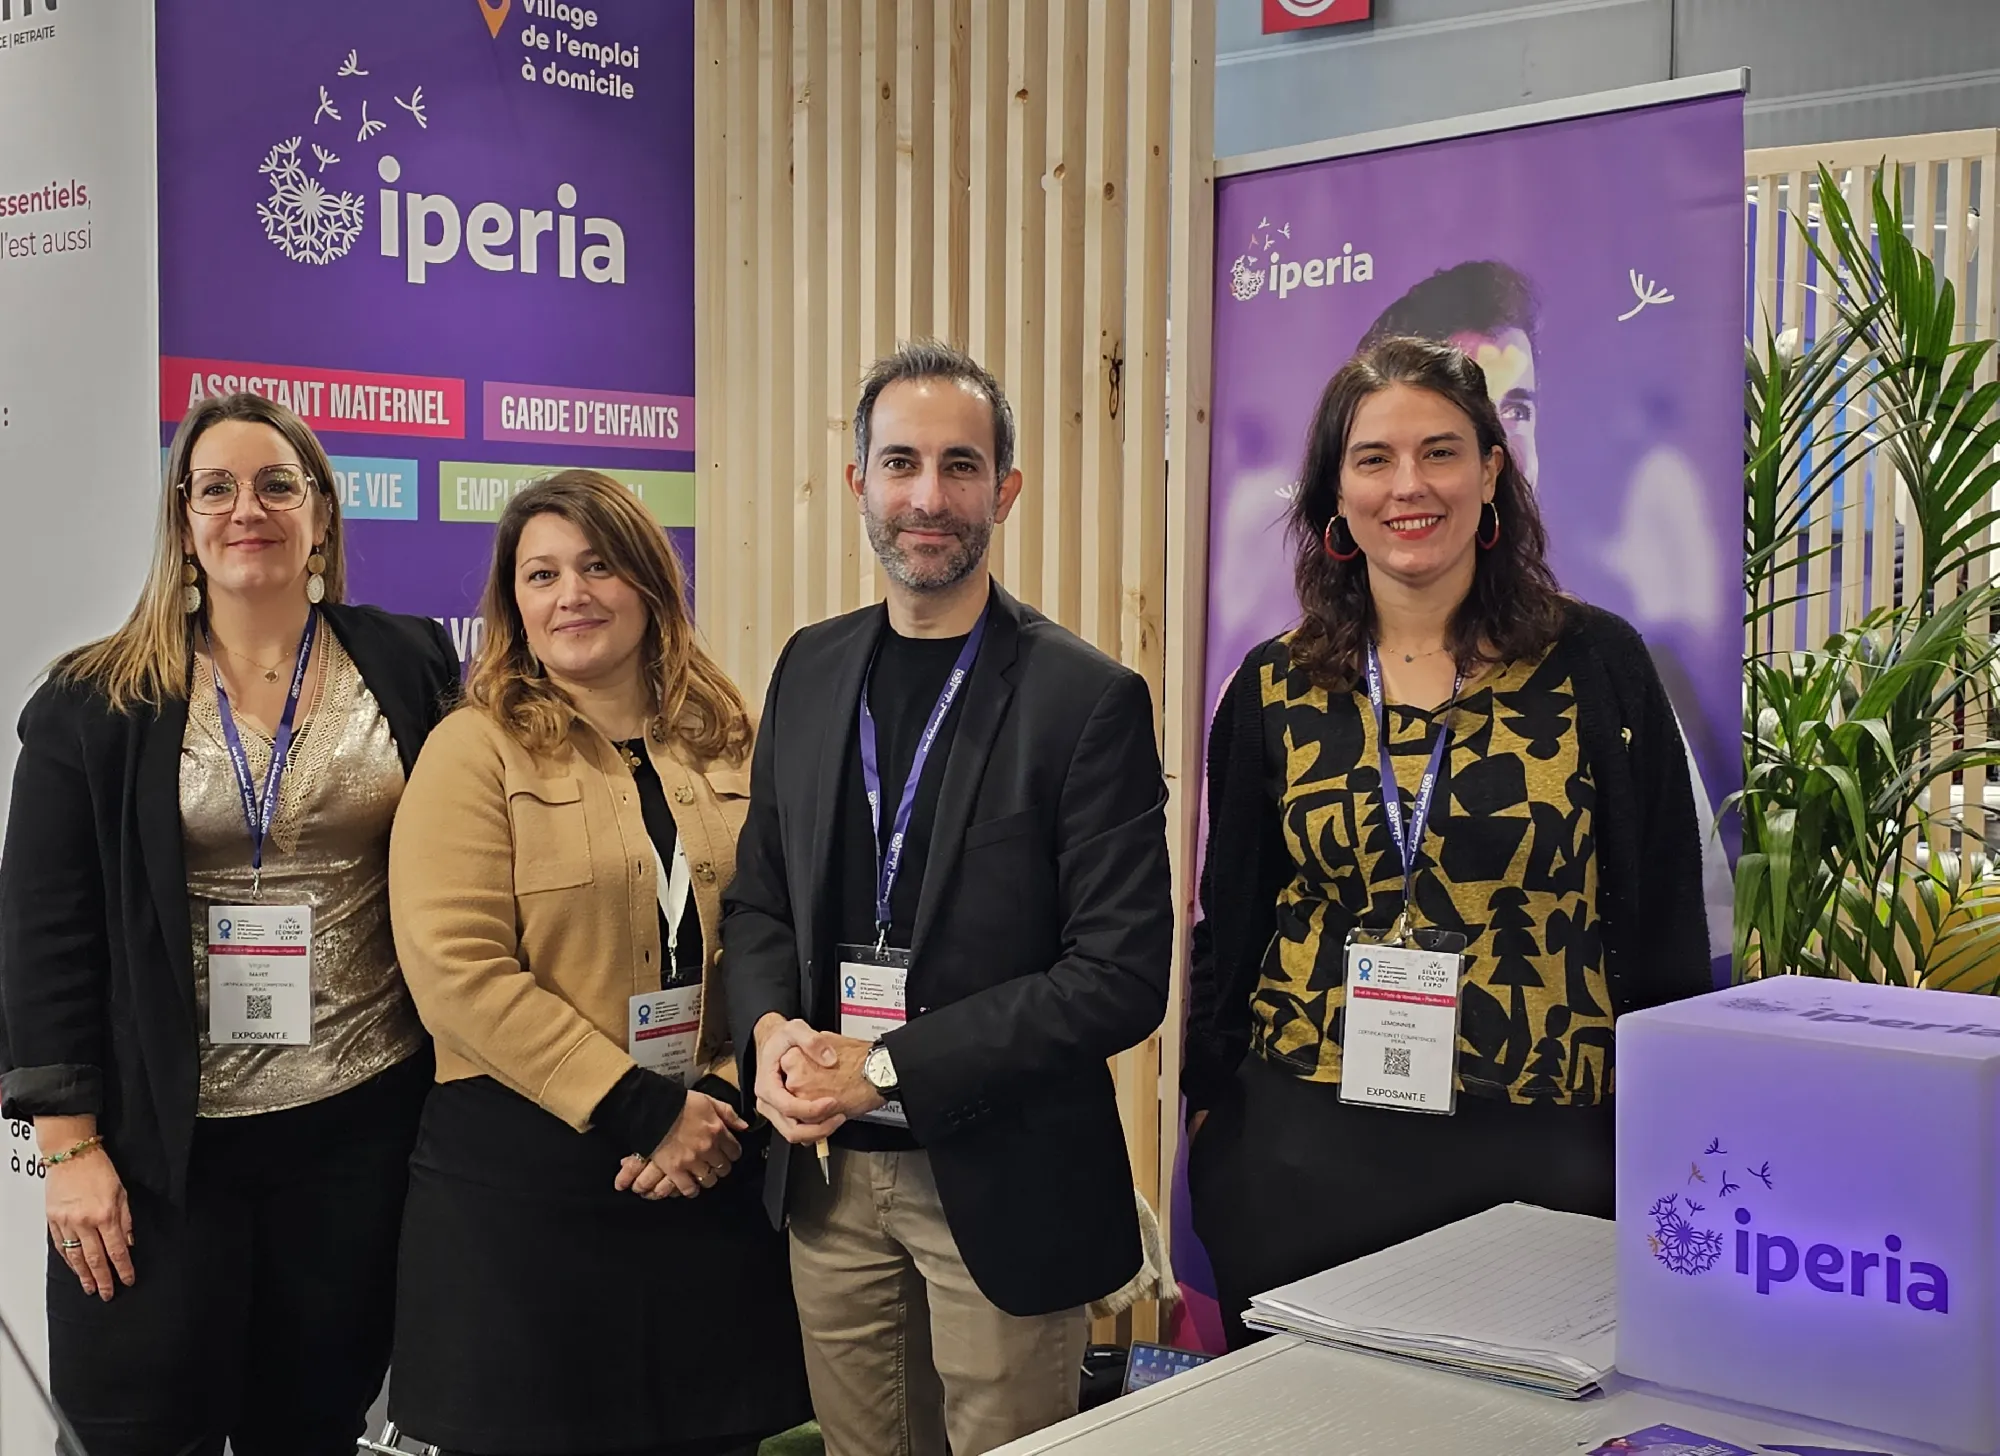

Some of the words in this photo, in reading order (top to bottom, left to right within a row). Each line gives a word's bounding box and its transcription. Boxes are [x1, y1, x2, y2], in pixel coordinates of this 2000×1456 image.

[523, 0, 597, 30] Village
[14, 25, 55, 45] RETRAITE
[521, 25, 549, 50] de
[556, 30, 639, 68] l'emploi
[521, 56, 536, 82] à
[543, 62, 634, 99] domicile
[377, 155, 625, 284] iperia
[43, 220, 91, 255] aussi
[1269, 242, 1373, 299] iperia
[330, 384, 450, 425] MATERNEL
[501, 395, 570, 433] GARDE
[574, 401, 679, 439] D'ENFANTS
[332, 471, 360, 507] DE
[365, 472, 403, 508] VIE
[1417, 975, 1449, 983] ECONOMY
[231, 1031, 288, 1040] EXPOSANT.E
[1796, 1007, 2000, 1038] iperia
[1366, 1087, 1426, 1102] EXPOSANT.E
[11, 1120, 31, 1140] de
[11, 1149, 20, 1173] à
[26, 1154, 46, 1179] do
[1734, 1207, 1949, 1314] iperia
